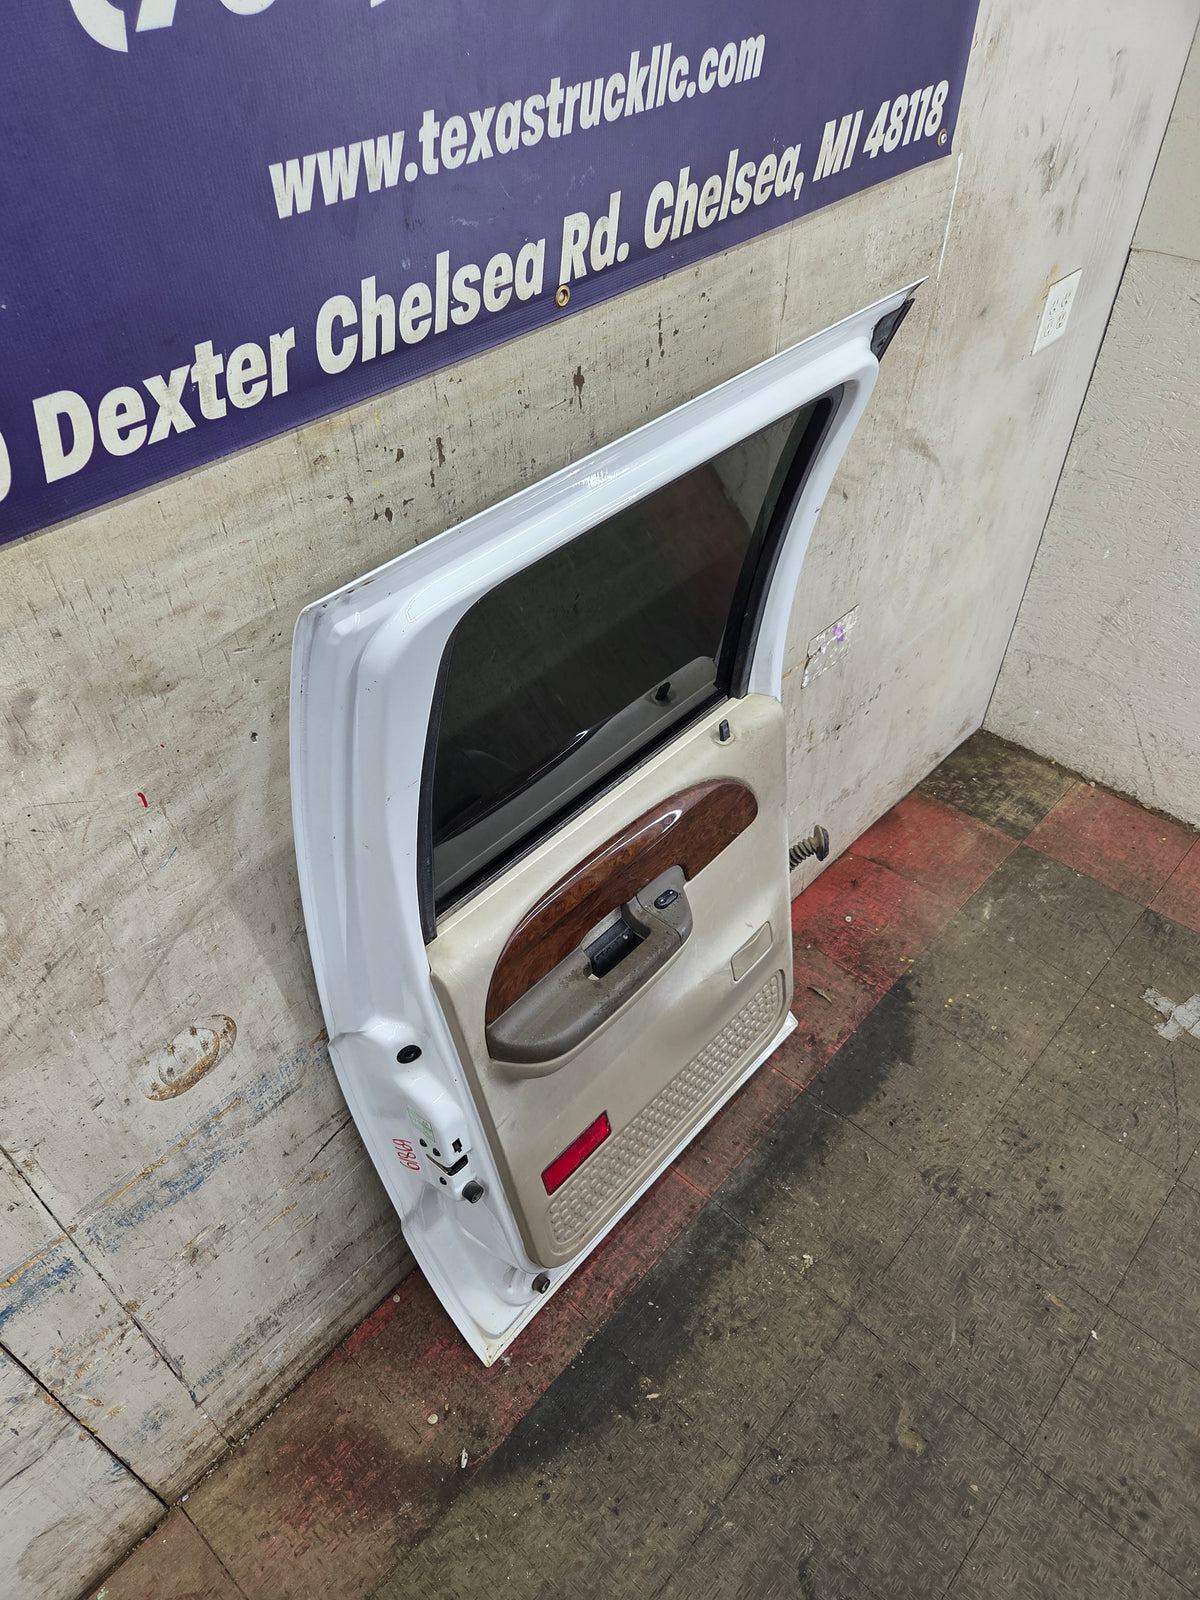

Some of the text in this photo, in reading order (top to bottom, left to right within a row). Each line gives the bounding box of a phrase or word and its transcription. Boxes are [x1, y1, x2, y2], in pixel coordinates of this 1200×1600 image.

[268, 33, 766, 220] www.texastruckllc.com
[31, 326, 296, 484] Dexter
[315, 237, 547, 375] Chelsea
[558, 189, 630, 286] Rd.
[644, 143, 804, 250] Chelsea,
[811, 108, 865, 183] MI
[862, 79, 950, 160] 48118
